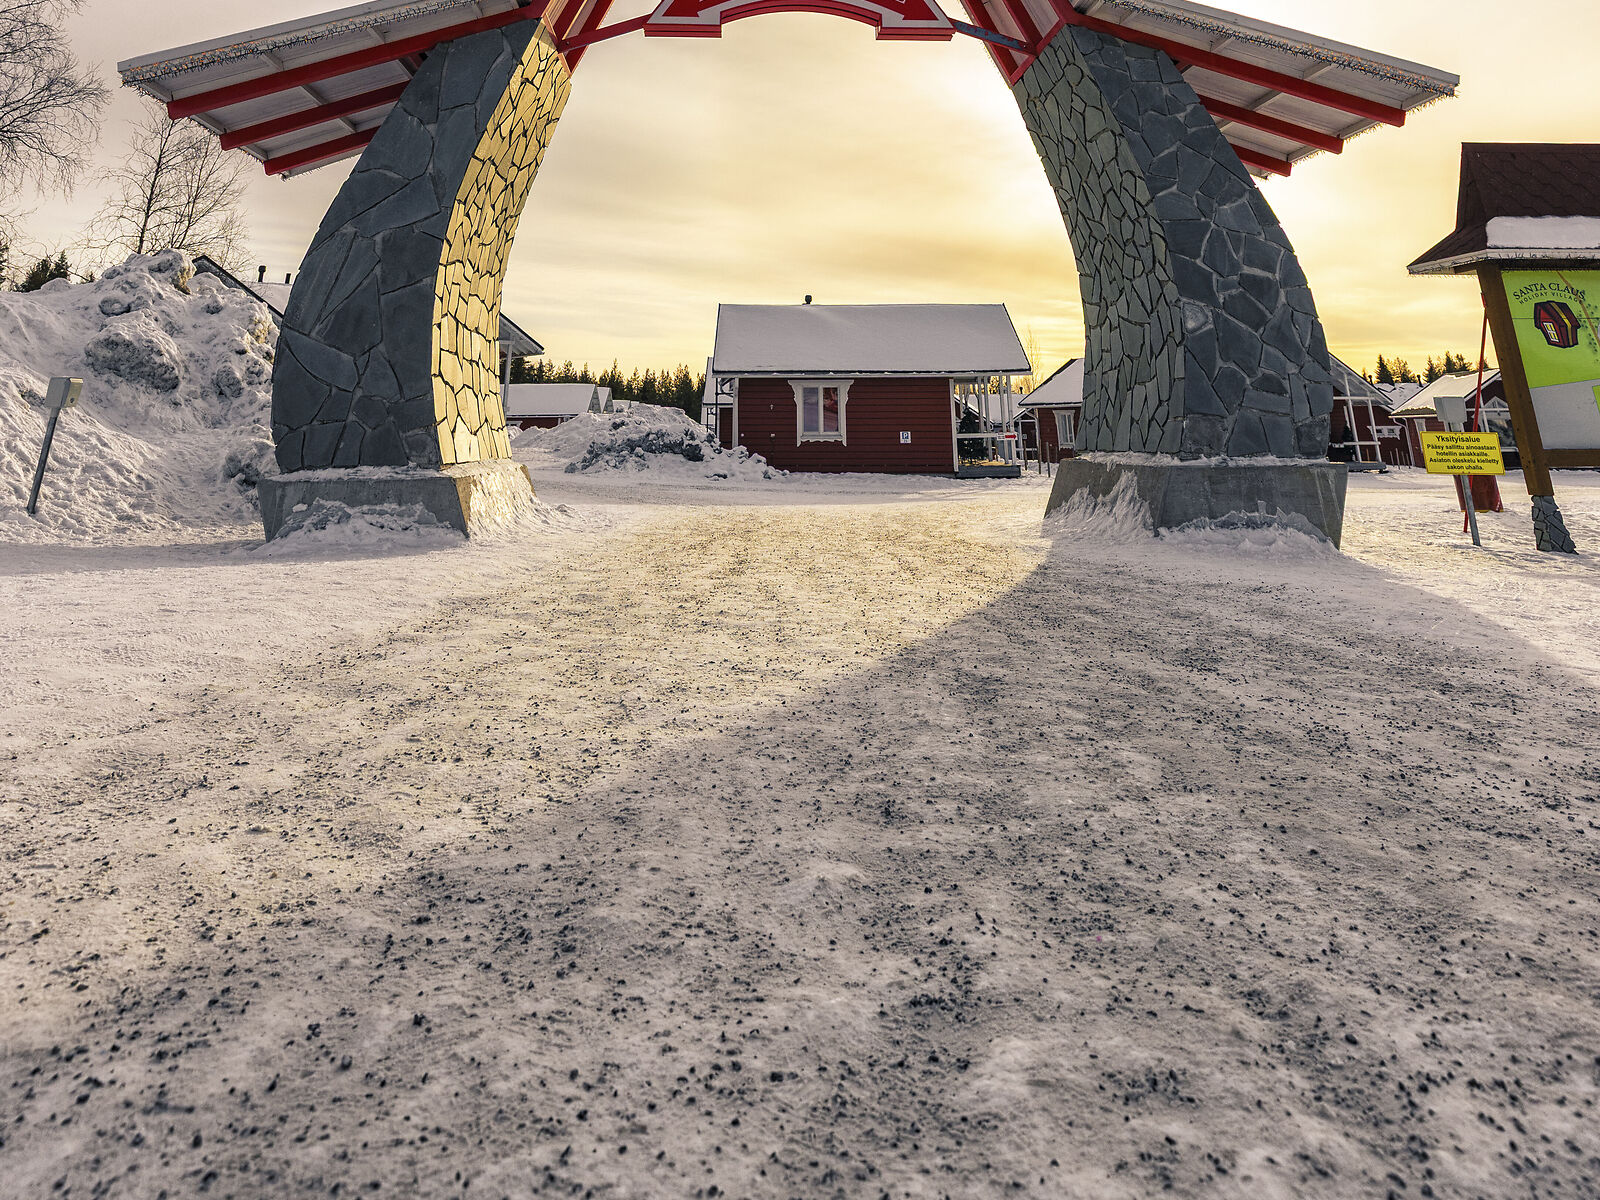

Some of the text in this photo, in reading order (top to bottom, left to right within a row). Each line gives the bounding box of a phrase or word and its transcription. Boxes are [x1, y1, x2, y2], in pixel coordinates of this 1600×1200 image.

[1513, 282, 1585, 300] SANTA CLAUS
[1518, 291, 1548, 305] HOLIDAY
[1435, 435, 1481, 443] Yksityisalue
